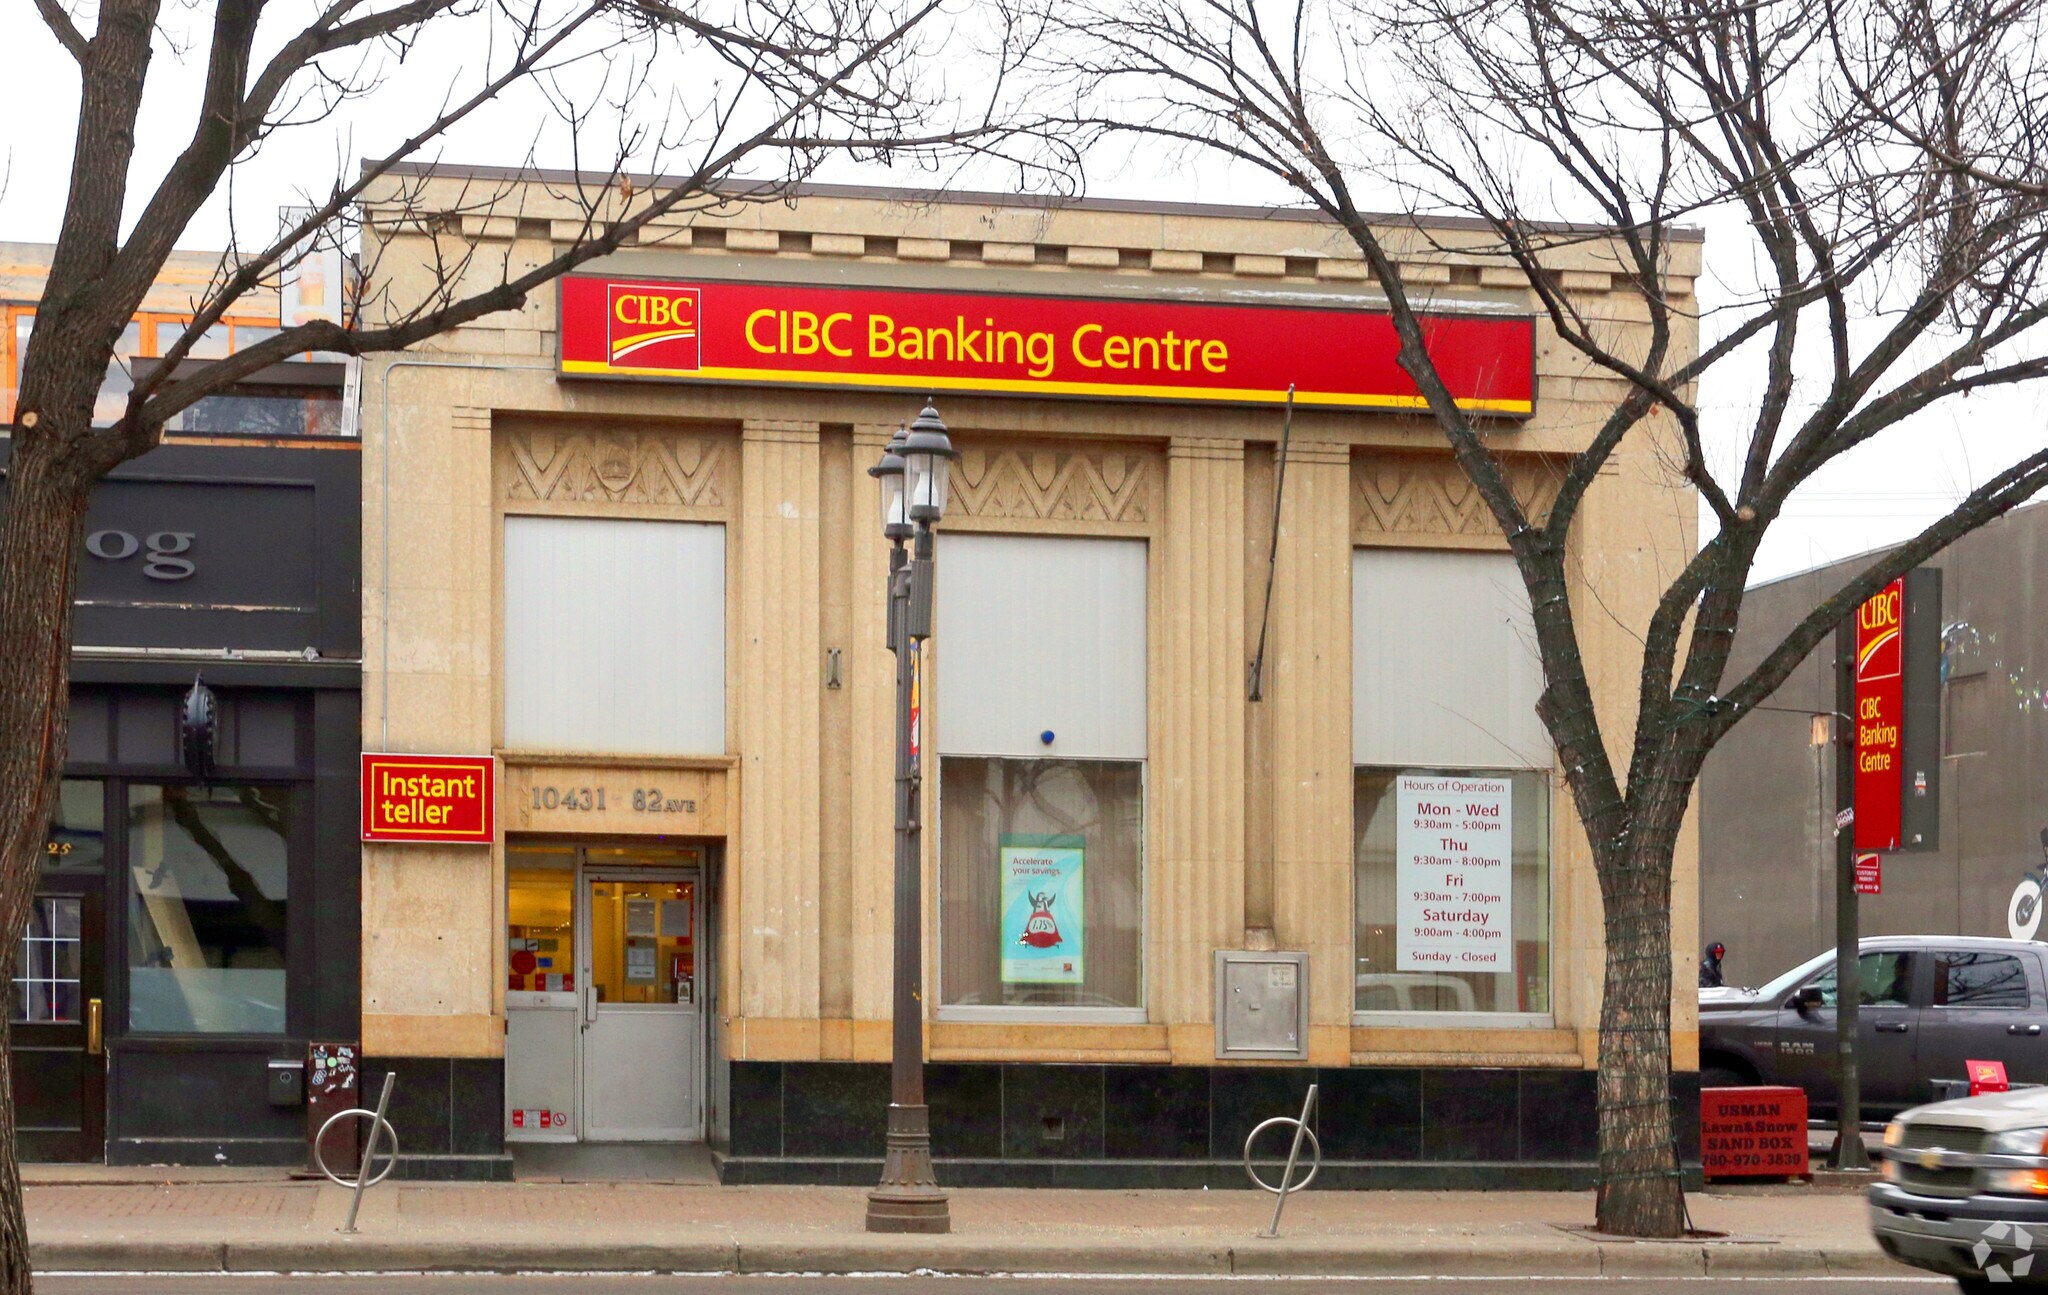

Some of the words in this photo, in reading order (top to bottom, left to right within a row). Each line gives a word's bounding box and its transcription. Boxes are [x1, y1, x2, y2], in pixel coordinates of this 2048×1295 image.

[615, 294, 693, 326] CIBC
[745, 308, 853, 357] CIBC
[867, 314, 1054, 378] Banking
[1072, 324, 1228, 373] Centre
[1861, 591, 1898, 630] CIBC
[1860, 696, 1881, 720] CIBC
[1860, 722, 1897, 748] Banking
[1860, 751, 1890, 772] Centre
[382, 771, 475, 799] Instant
[1404, 780, 1434, 791] Hours
[1437, 781, 1448, 791] of
[1452, 781, 1505, 794] Operation
[532, 786, 607, 812] 10431
[382, 799, 453, 825] teller
[1417, 803, 1451, 815] Mon
[1466, 804, 1499, 817] Wed
[1413, 820, 1452, 829] 9:30am
[1462, 821, 1501, 832] 5:00pm
[1440, 838, 1468, 851] Thu
[1012, 857, 1053, 866] Accelerate
[1413, 856, 1452, 866] 9:30am
[1462, 857, 1501, 868] 8:00pm
[1012, 867, 1030, 876] your
[1446, 874, 1463, 887] Fri
[1413, 892, 1452, 901] 9:30am
[1462, 892, 1501, 904] 7:00pm
[1423, 909, 1489, 925] Saturday
[1414, 928, 1452, 937] 9:00am
[1462, 928, 1501, 939] 4:00pm
[1412, 952, 1451, 963] Sunday
[1461, 952, 1497, 962] Closed
[1780, 1041, 1814, 1049] RAM
[1718, 1103, 1780, 1117] USMAN
[1707, 1137, 1755, 1150] SAND
[1758, 1137, 1793, 1149] BOX
